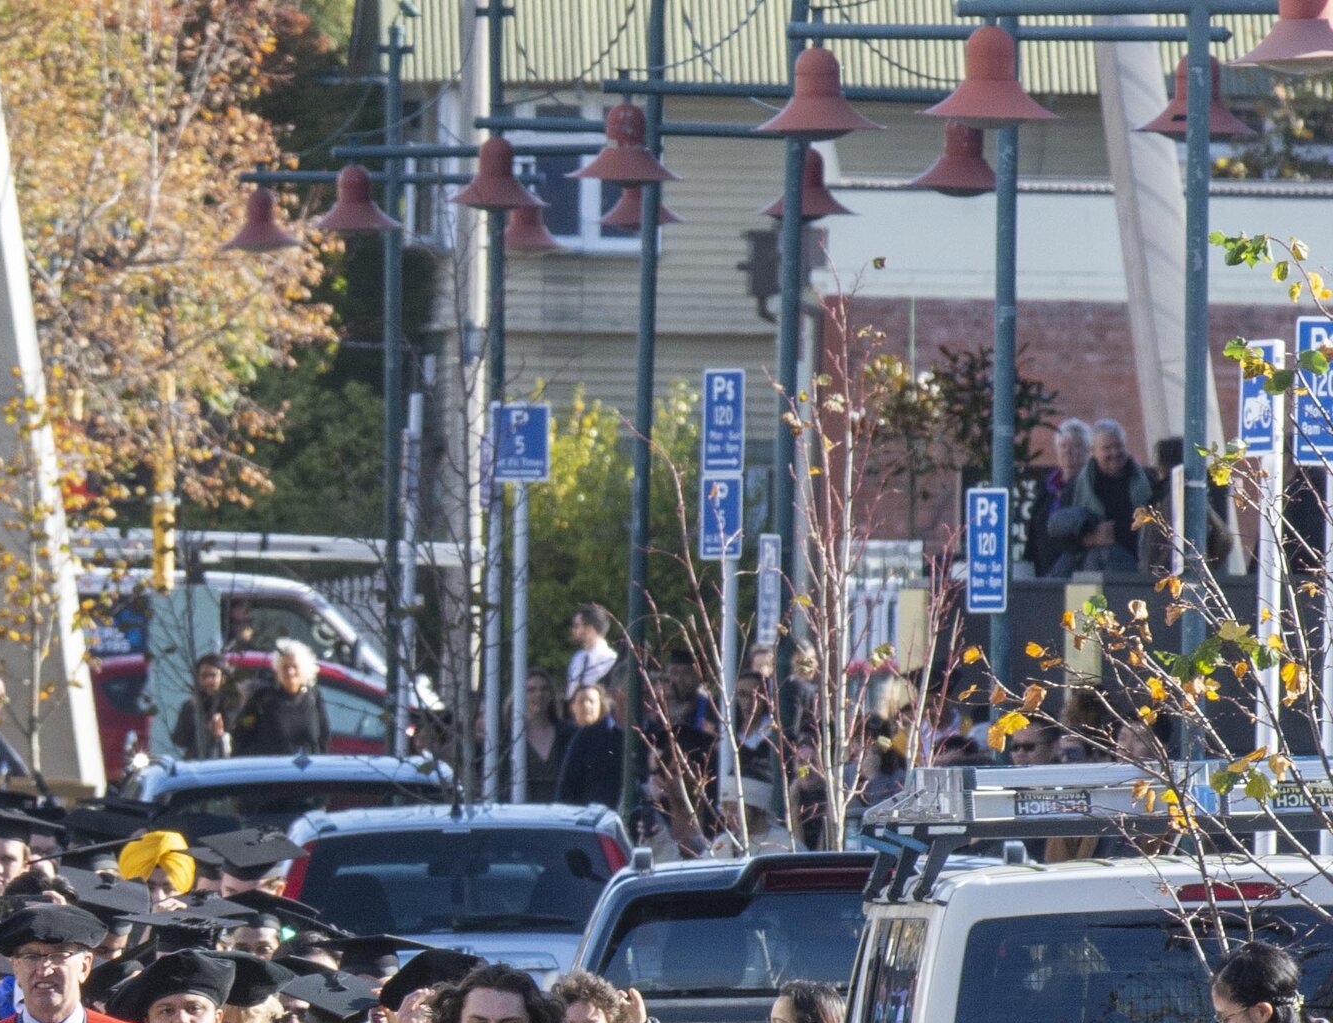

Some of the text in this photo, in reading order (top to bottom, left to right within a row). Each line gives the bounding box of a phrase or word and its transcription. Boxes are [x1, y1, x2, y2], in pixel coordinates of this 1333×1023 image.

[511, 410, 529, 434] P
[713, 405, 733, 426] 120
[515, 435, 525, 455] 5
[978, 532, 997, 556] 120
